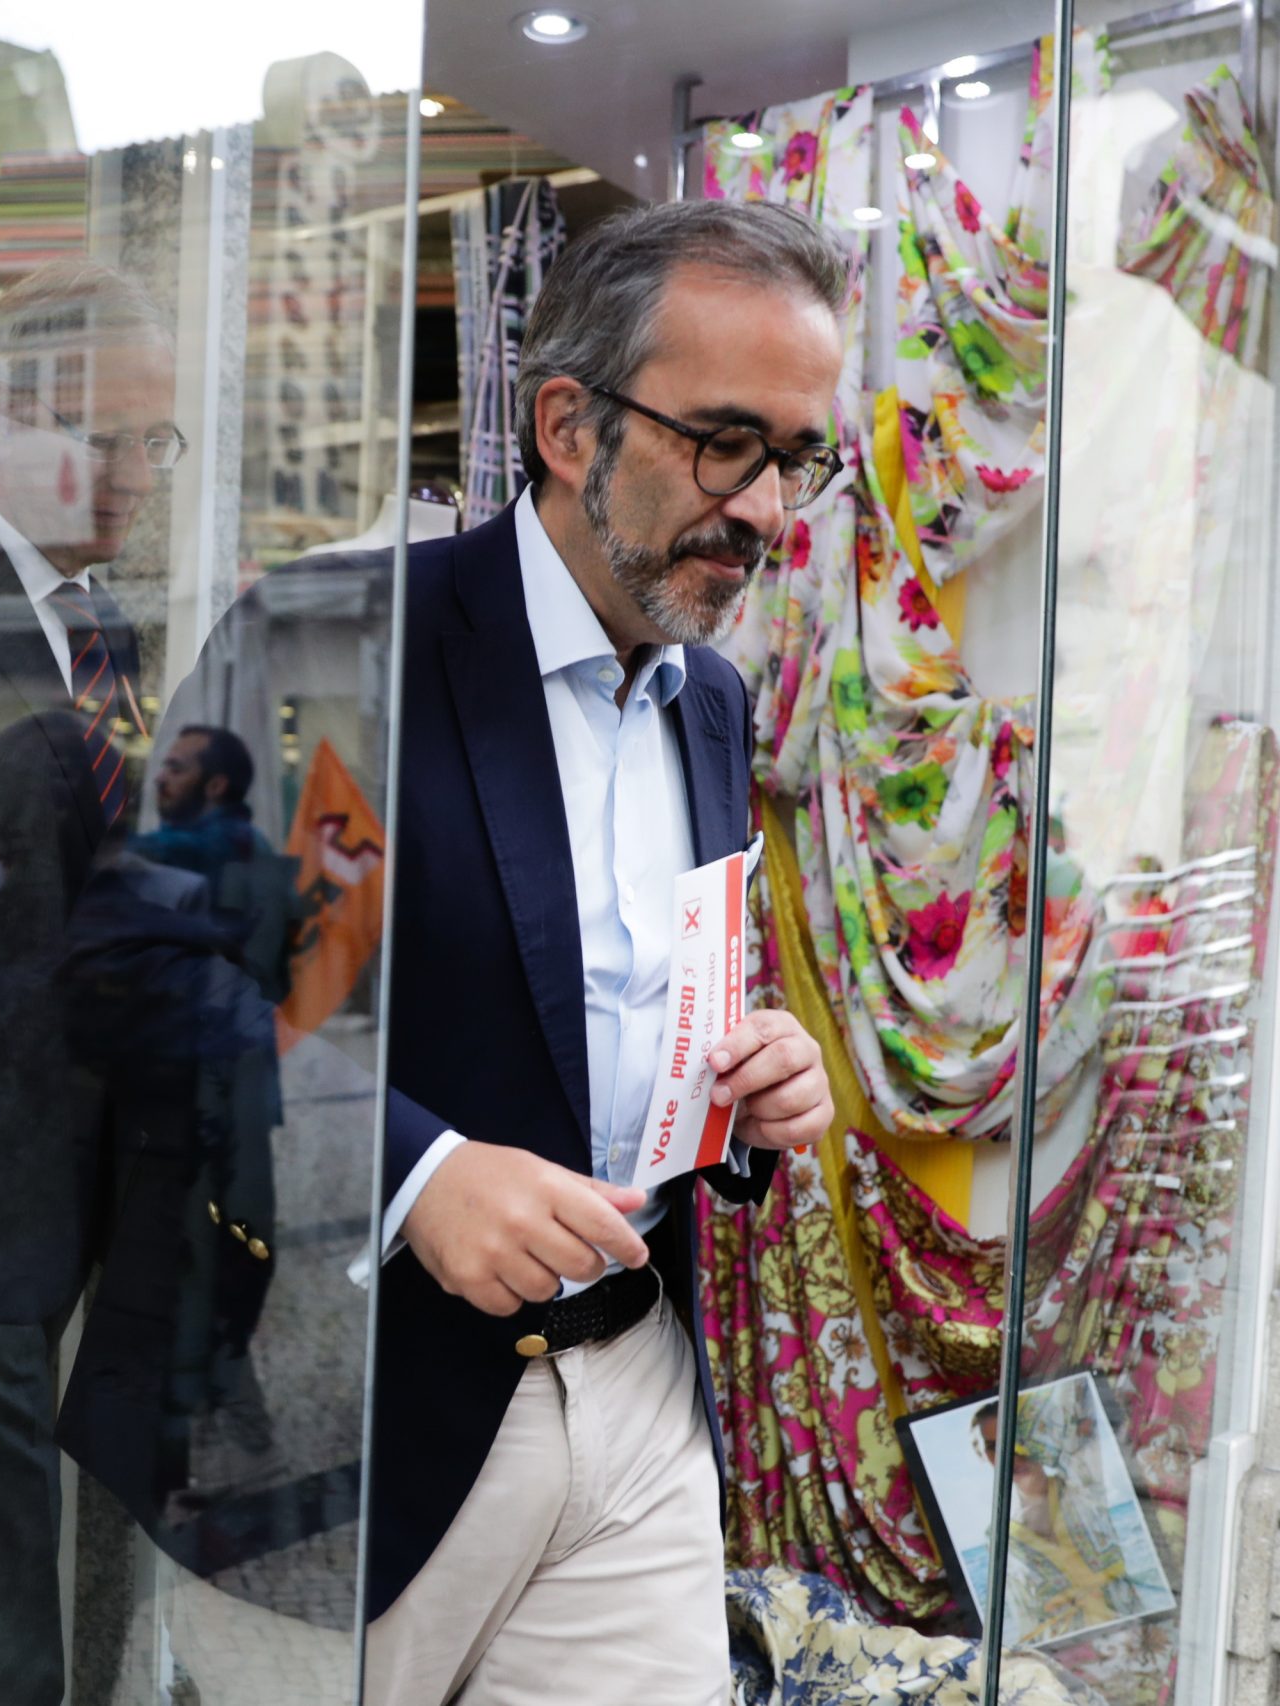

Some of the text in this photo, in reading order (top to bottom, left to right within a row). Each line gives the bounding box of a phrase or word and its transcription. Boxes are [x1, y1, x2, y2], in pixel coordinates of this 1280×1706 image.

[730, 935, 739, 988] 2019
[691, 952, 716, 1100] Dia 26 de maio
[650, 1100, 678, 1167] Vote
